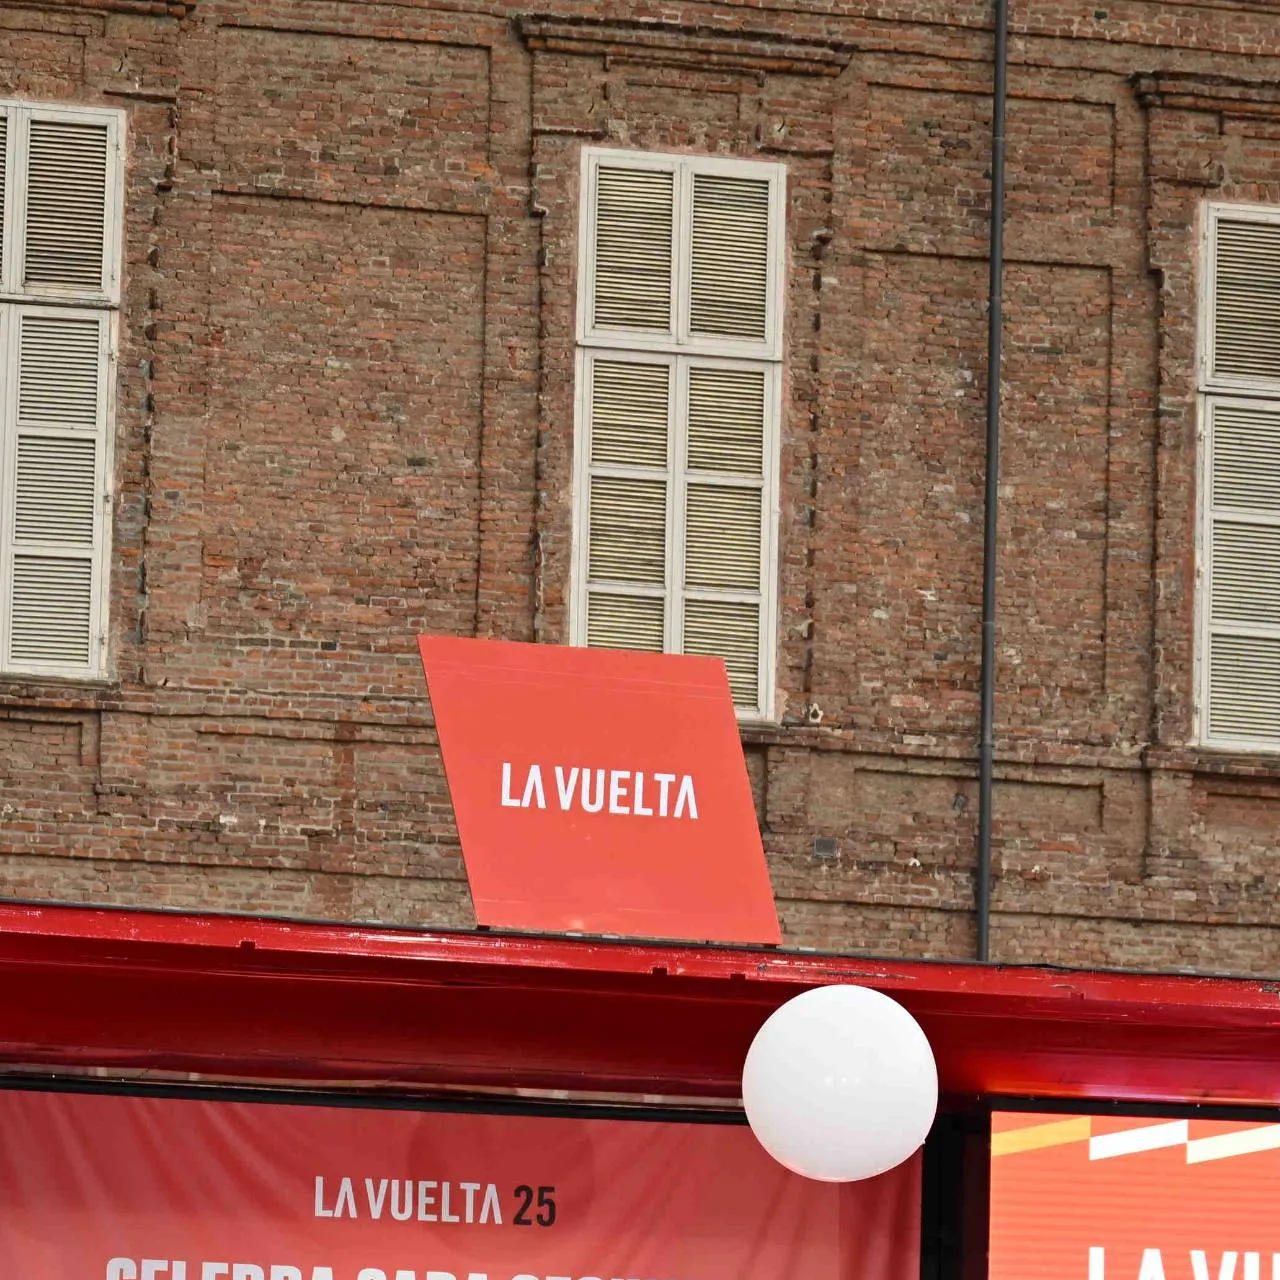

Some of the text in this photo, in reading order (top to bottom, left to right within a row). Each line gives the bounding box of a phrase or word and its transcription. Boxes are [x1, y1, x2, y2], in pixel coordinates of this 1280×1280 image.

[501, 762, 698, 820] LA VUELTA
[314, 1176, 557, 1228] LA VUELTA 25
